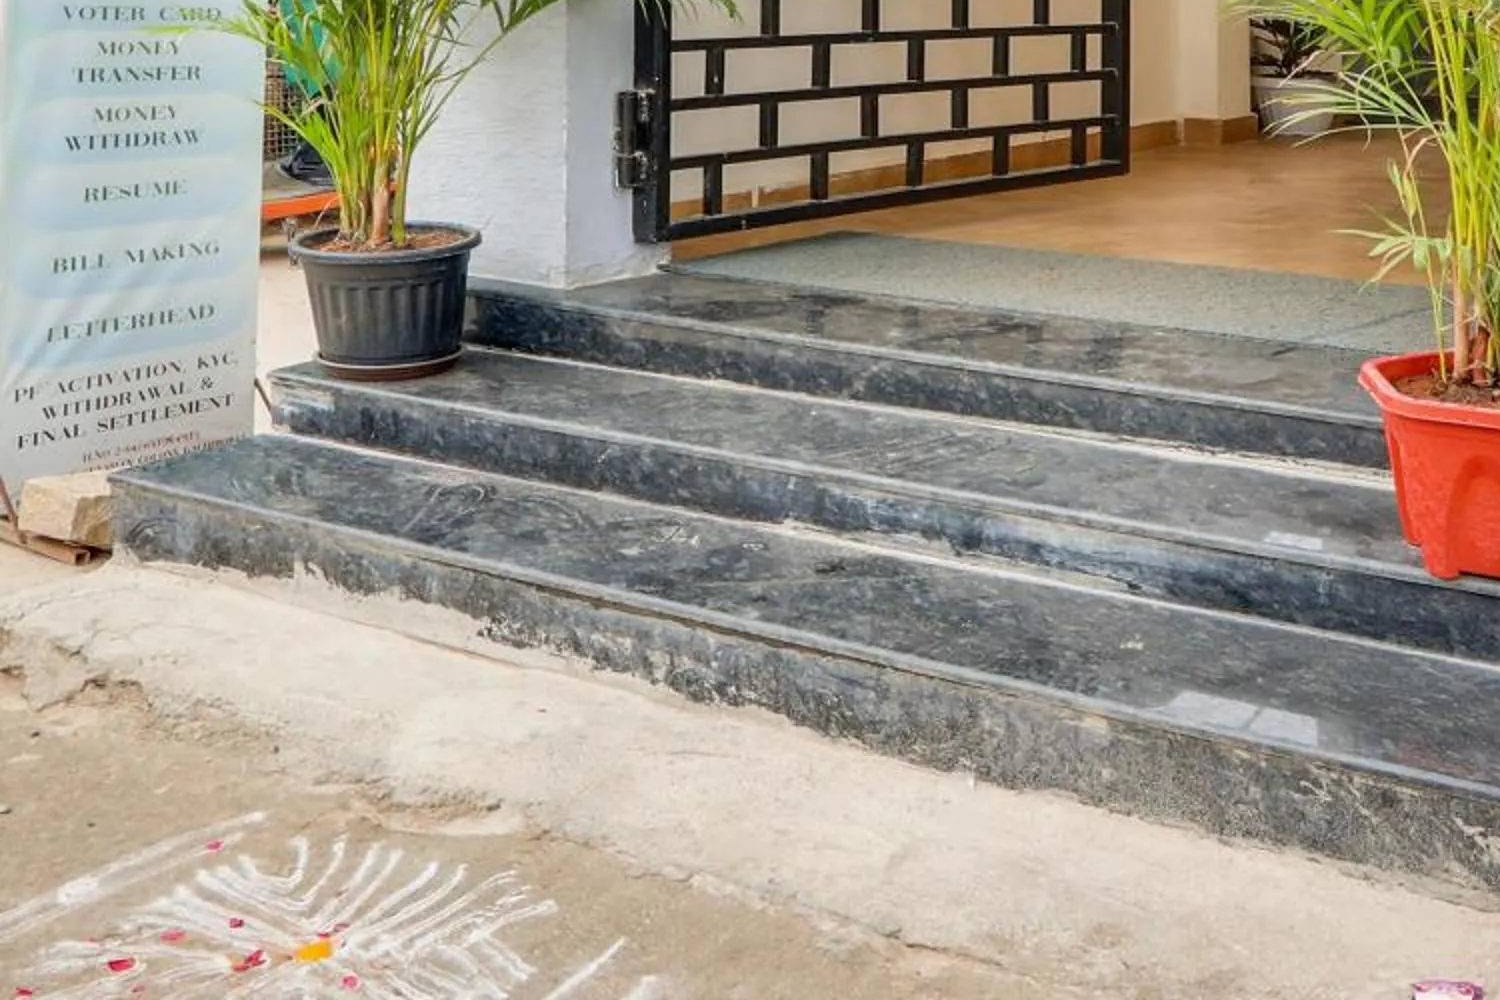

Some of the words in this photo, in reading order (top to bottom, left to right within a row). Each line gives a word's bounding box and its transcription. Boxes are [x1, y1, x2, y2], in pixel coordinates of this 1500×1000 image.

[63, 5, 146, 22] VOTER
[159, 6, 222, 24] CARD
[97, 40, 181, 56] MONEY
[72, 65, 202, 84] TRANSFER
[93, 104, 179, 123] MONEY
[64, 129, 201, 151] WITHDRAW
[84, 179, 188, 203] RESUME
[53, 253, 111, 274] BILL
[125, 241, 220, 264] MAKING
[46, 303, 216, 343] LETTERHEAD
[42, 381, 188, 420] WITHDRAWAL
[199, 376, 214, 391] &
[17, 423, 85, 450] FINAL
[97, 393, 235, 433] SETTLEMENT
